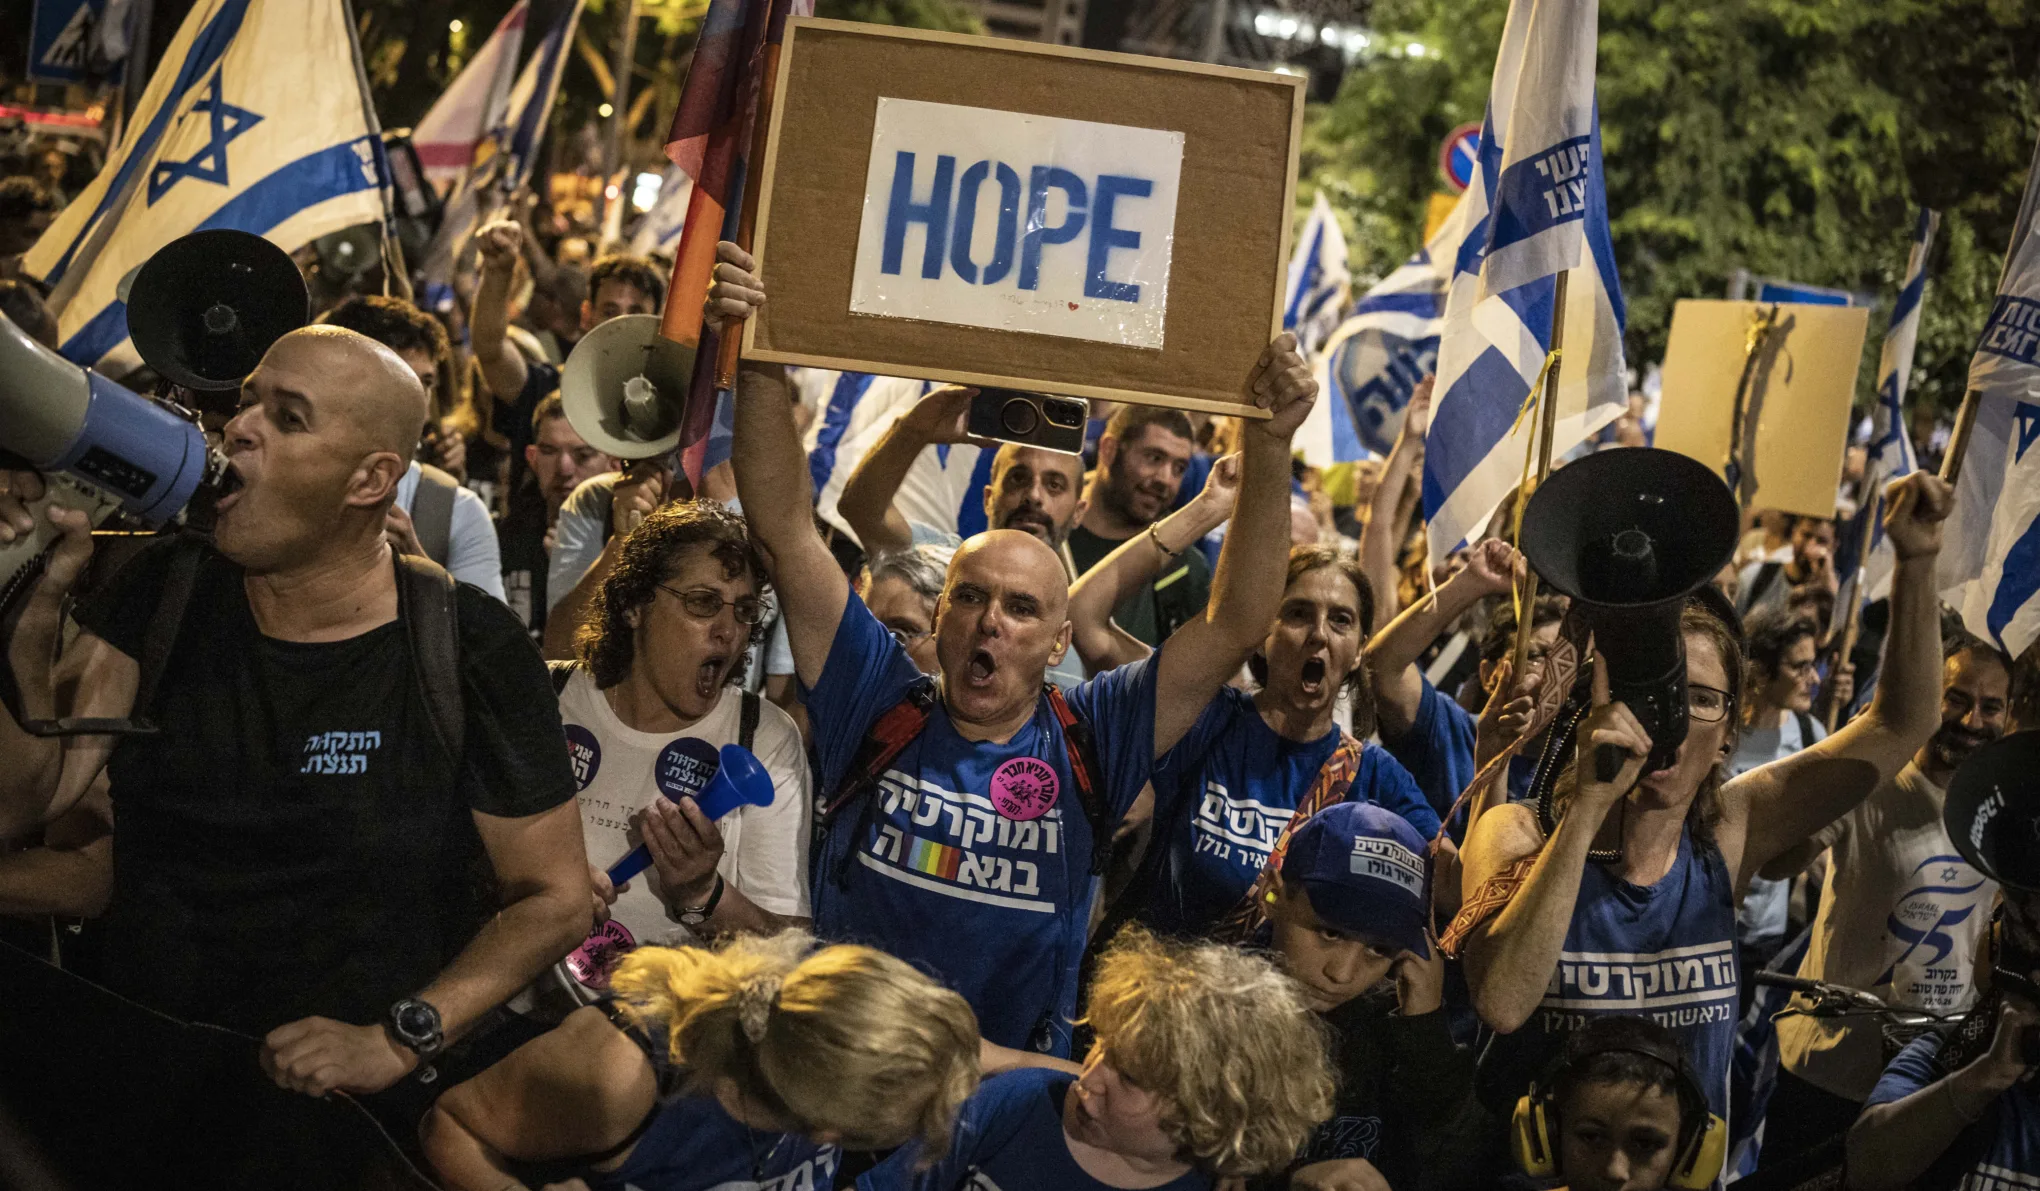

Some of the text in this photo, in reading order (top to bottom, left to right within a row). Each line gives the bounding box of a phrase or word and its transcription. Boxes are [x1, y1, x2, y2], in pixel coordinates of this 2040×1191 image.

[881, 150, 1153, 303] HOPE
[300, 753, 367, 774] תנצח.
[1001, 761, 1024, 778] חבר
[1026, 762, 1051, 782] מביא
[1199, 793, 1289, 849] קרטים
[1195, 834, 1268, 871] איר גולן
[1367, 860, 1392, 877] גולן
[1925, 968, 1957, 981] בקרוב
